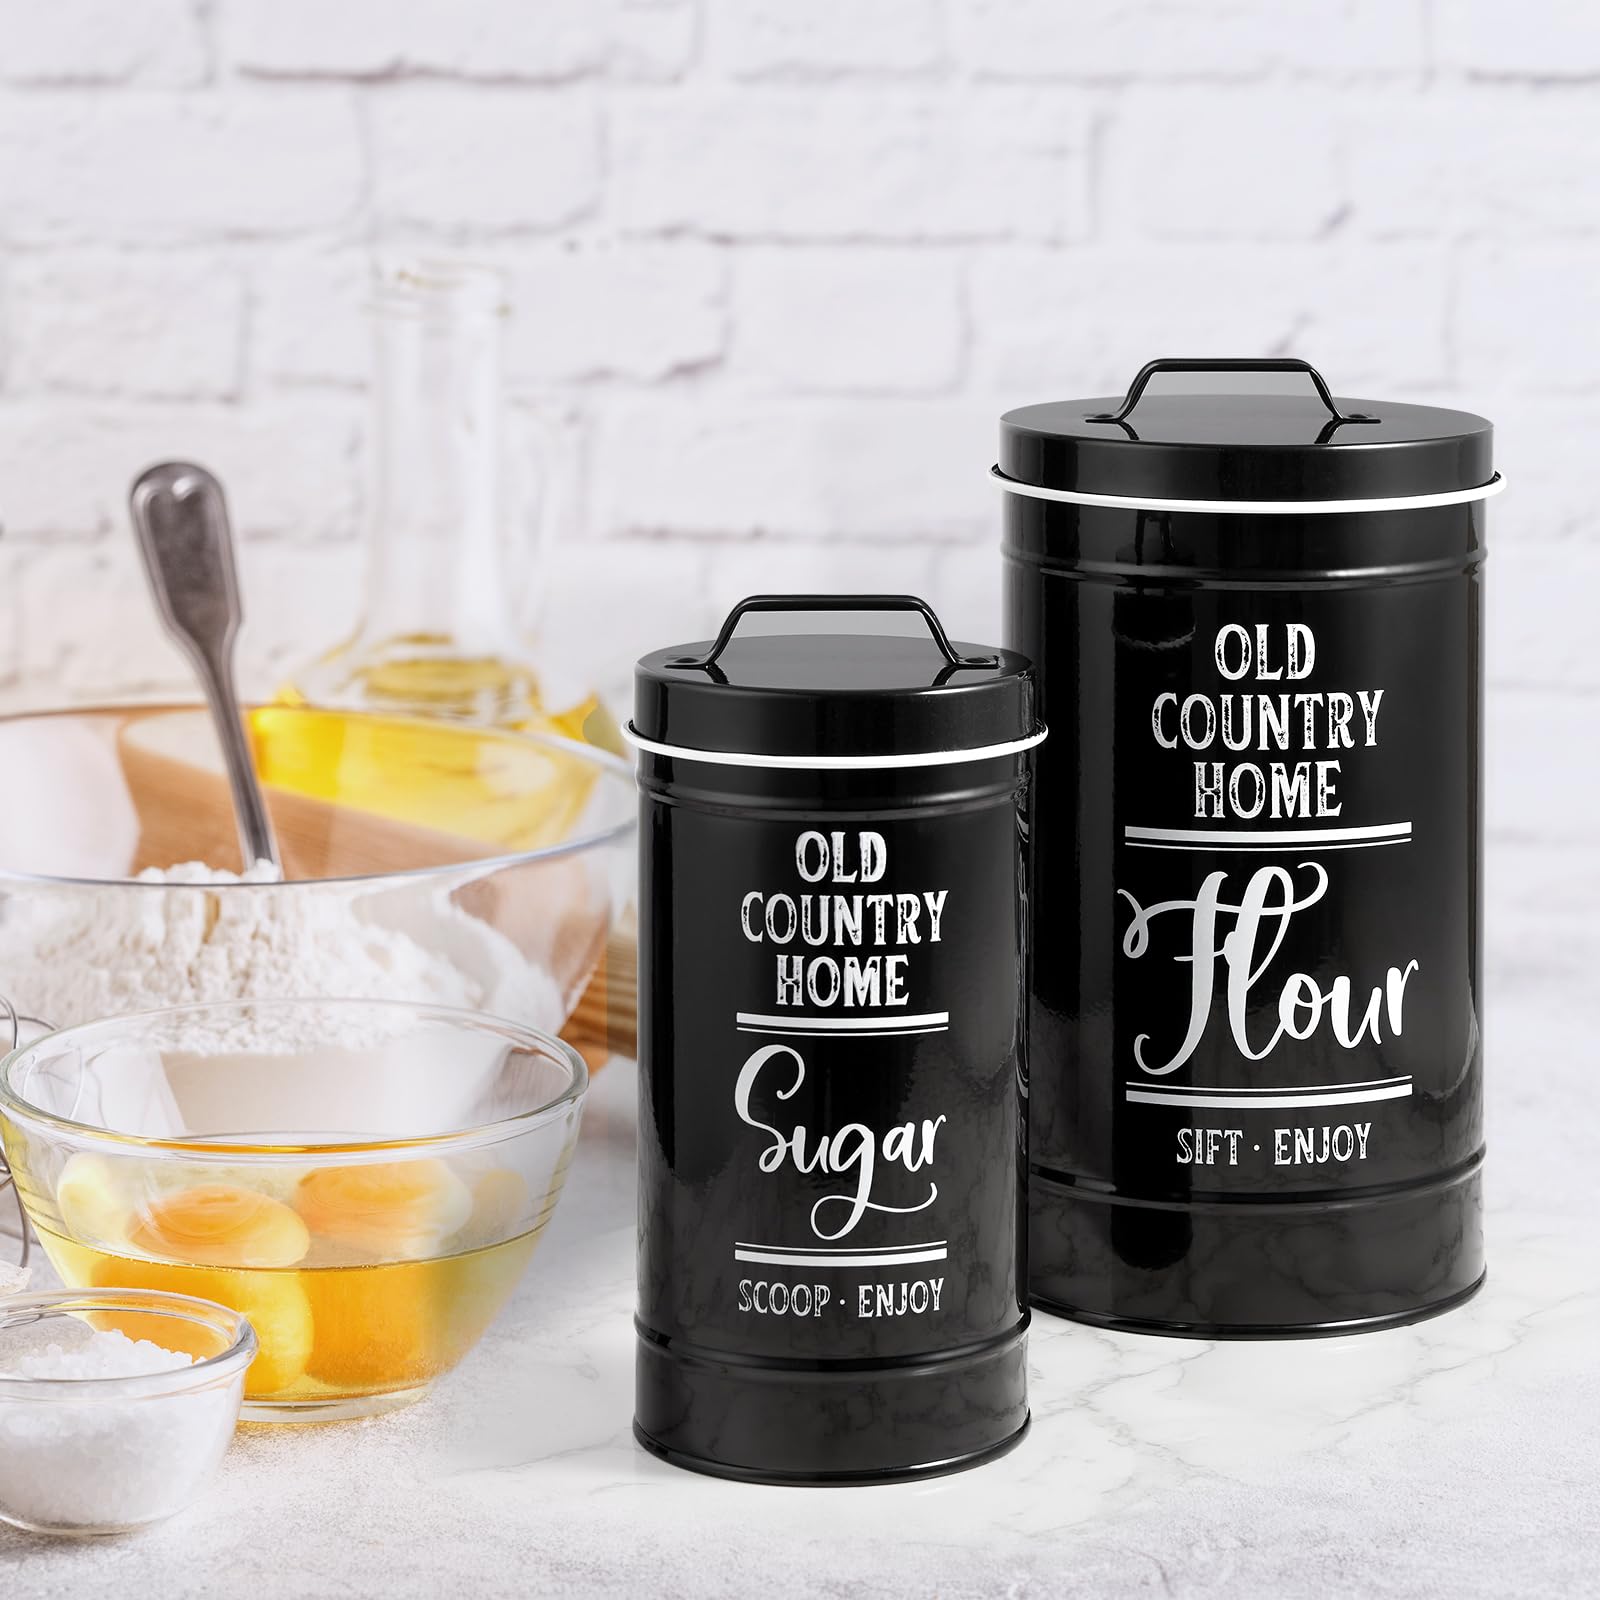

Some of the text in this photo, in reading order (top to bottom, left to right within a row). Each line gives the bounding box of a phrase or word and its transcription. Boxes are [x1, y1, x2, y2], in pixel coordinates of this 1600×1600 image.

[1215, 624, 1315, 680] OLD
[1152, 690, 1384, 750] COUNTRY
[1194, 760, 1342, 819] HOME
[796, 831, 886, 883] OLD
[741, 890, 948, 945] COUNTRY
[776, 954, 909, 1007] HOME
[1117, 862, 1419, 1075] Flour
[735, 1045, 947, 1240] Sugar
[1177, 1123, 1371, 1165] SIFT ENJOY
[739, 1278, 944, 1317] SCOOP ENJOY
